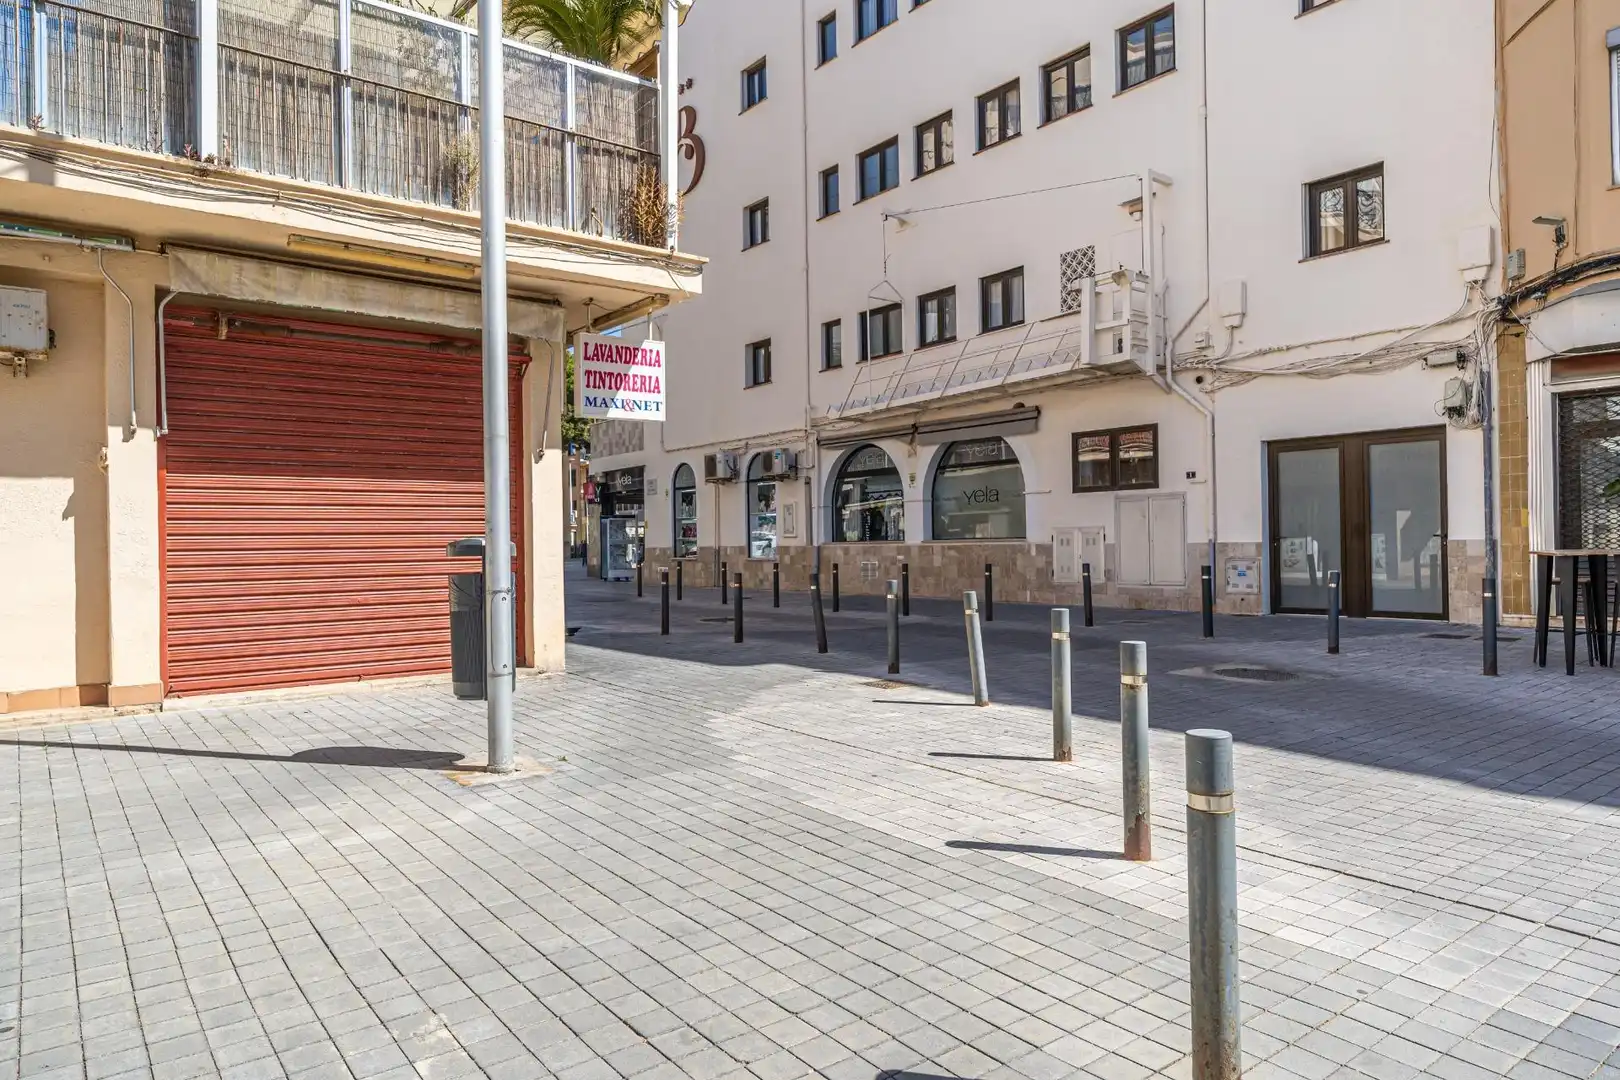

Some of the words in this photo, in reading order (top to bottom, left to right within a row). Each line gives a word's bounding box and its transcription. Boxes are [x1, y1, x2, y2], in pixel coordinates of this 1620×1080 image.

[583, 342, 662, 368] LAVANDERIA
[584, 369, 662, 394] TINTORERIA
[584, 396, 662, 412] MAXI&NET
[963, 486, 1000, 505] yela
